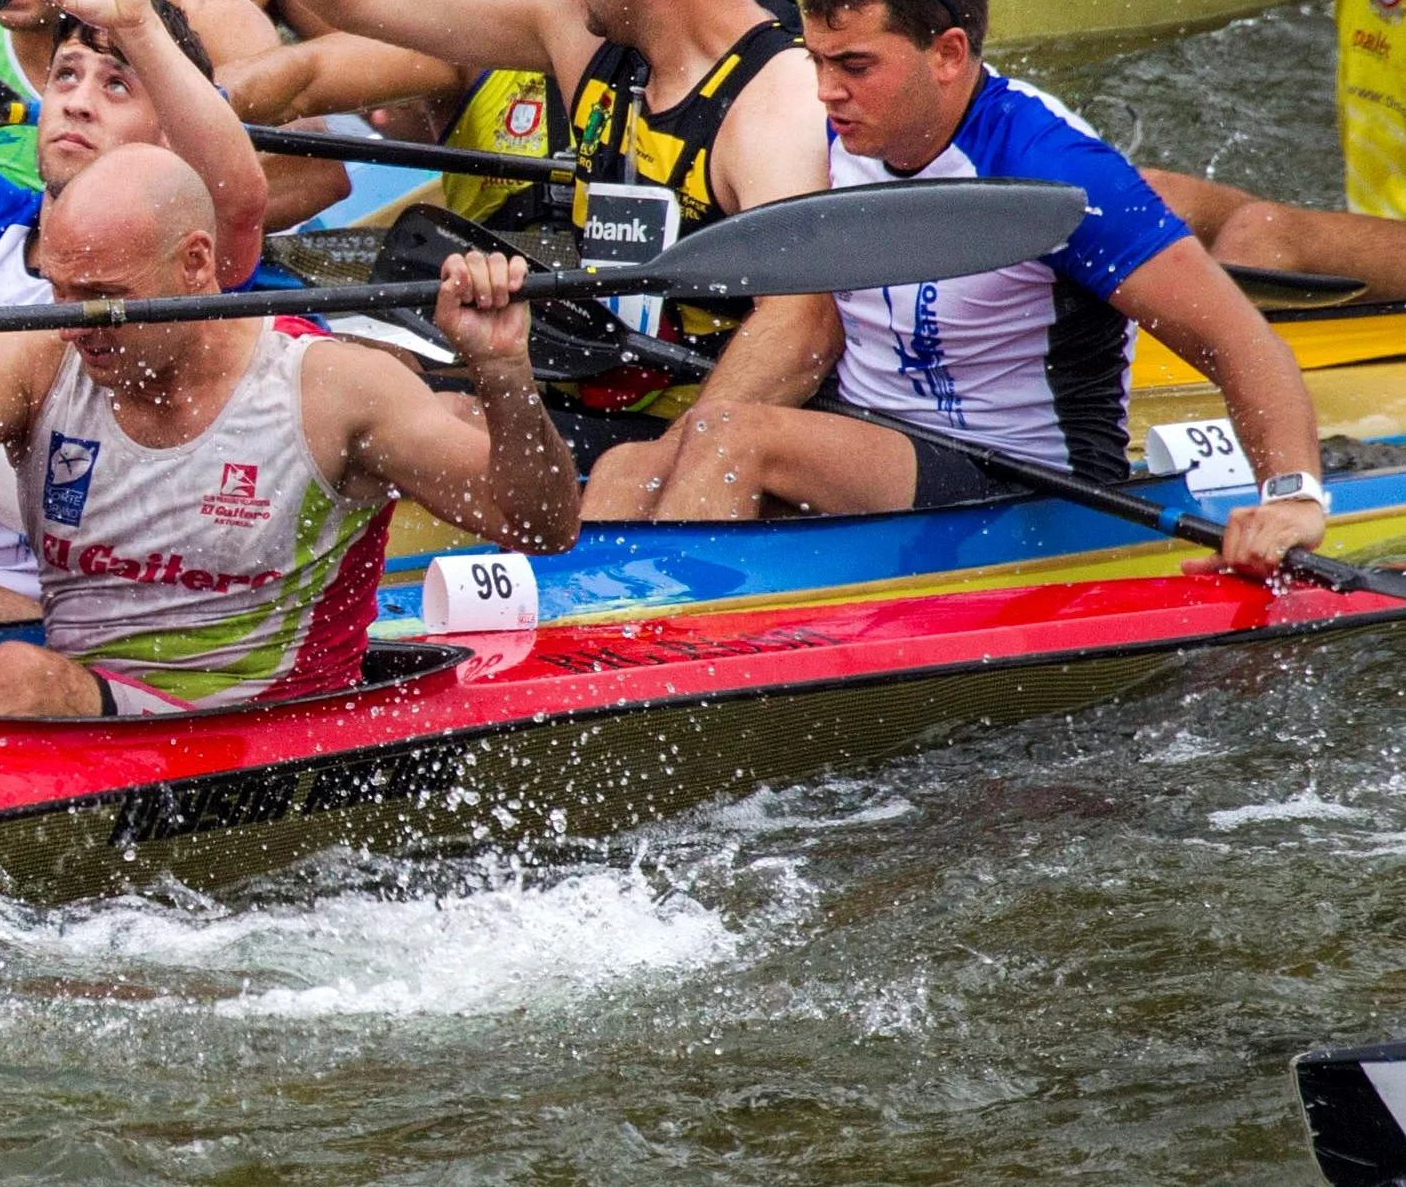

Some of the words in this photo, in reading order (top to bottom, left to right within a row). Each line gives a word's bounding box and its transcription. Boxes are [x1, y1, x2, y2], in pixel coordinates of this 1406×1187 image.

[583, 214, 648, 243] rbank
[1186, 425, 1234, 458] 93
[42, 534, 72, 570] El
[77, 544, 284, 595] Gaitero
[471, 562, 513, 600] 96
